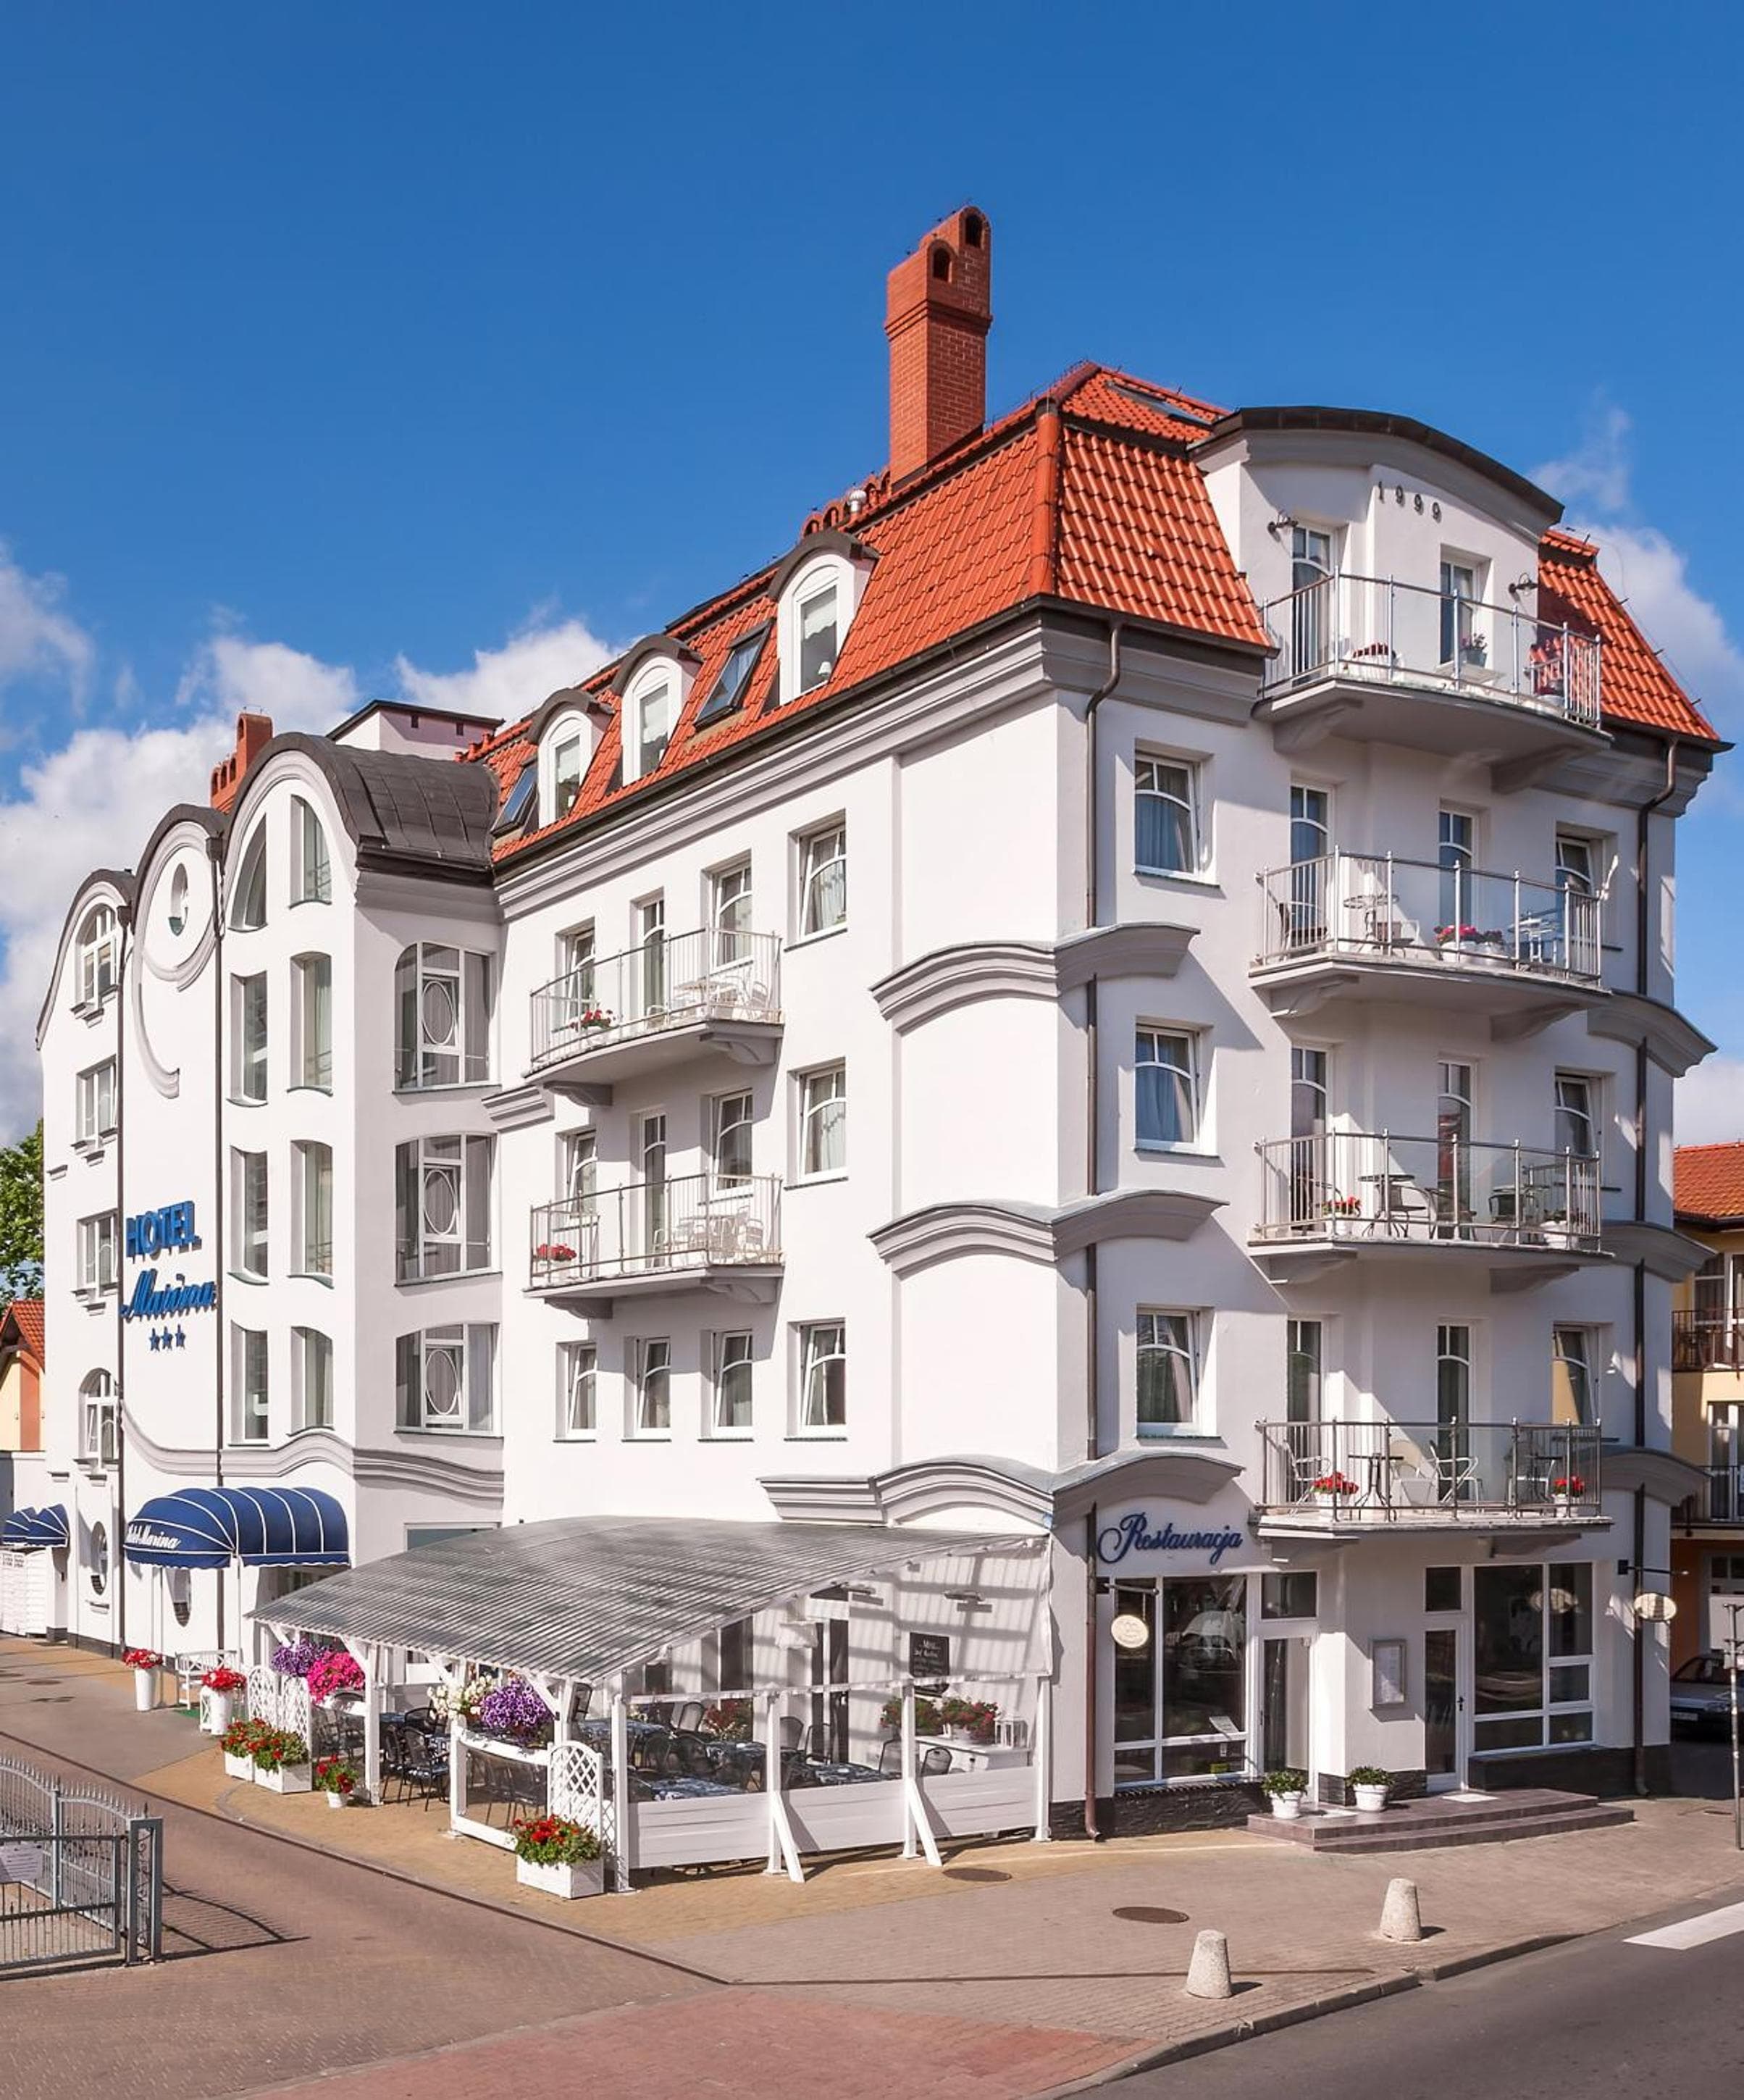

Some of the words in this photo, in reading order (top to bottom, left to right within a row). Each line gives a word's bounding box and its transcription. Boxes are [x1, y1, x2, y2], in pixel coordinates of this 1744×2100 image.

[1378, 481, 1441, 520] 1999
[126, 1200, 199, 1258] HOTEL
[120, 1269, 217, 1318] Marina
[140, 1524, 181, 1549] Marina
[1098, 1512, 1243, 1564] Restauracja
